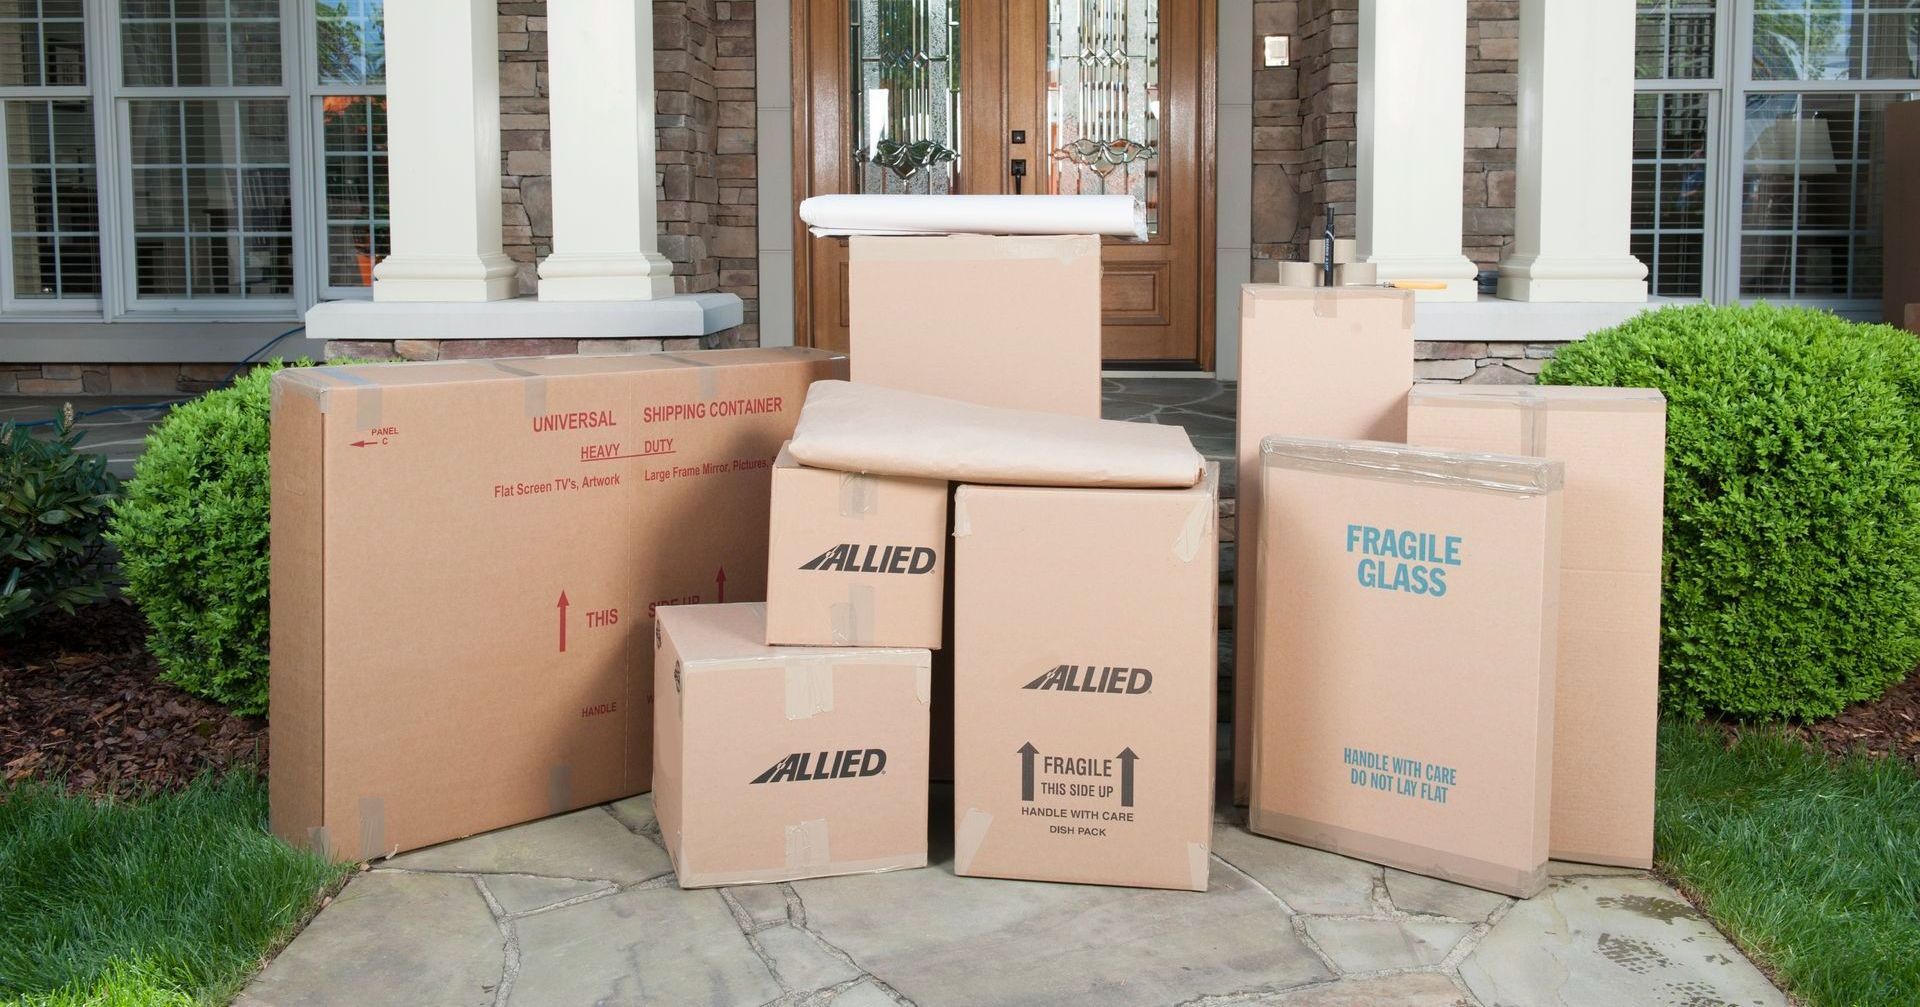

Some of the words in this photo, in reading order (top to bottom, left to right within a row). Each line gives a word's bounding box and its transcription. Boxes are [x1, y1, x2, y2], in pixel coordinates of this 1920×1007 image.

[533, 411, 617, 432] UNIVERSAL
[643, 403, 706, 423] SHIPPING
[709, 397, 783, 418] CONTAINER
[371, 427, 399, 436] PANEL
[382, 437, 388, 445] C
[580, 443, 620, 459] HEAVY
[644, 438, 674, 454] DUTY
[494, 484, 514, 498] Flat
[517, 481, 552, 496] Screen
[555, 478, 579, 491] TV's,
[581, 473, 620, 488] Artwork
[644, 468, 671, 482] Large
[673, 465, 700, 478] Frame
[702, 462, 731, 475] Mirror,
[733, 458, 769, 472] Pictures,
[1346, 524, 1462, 566] FRAGILE
[798, 544, 937, 574] ALLIED
[1357, 558, 1447, 597] GLASS
[586, 608, 618, 628] THIS
[1021, 665, 1153, 694] ALLIED
[582, 702, 617, 718] HANDLE
[749, 748, 887, 784] ALLIED
[1044, 756, 1112, 777] FRAGILE
[1344, 747, 1389, 771] HANDLE
[1392, 757, 1422, 778] WITH
[1426, 763, 1457, 785] CARE
[1041, 782, 1066, 796] THIS
[1069, 783, 1095, 797] SIDE
[1098, 785, 1114, 798] UP
[1351, 768, 1367, 786] DO
[1370, 772, 1394, 791] NOT
[1397, 777, 1417, 797] LAY
[1421, 782, 1448, 803] FLAT
[1021, 807, 1068, 818] HANDLE
[1070, 809, 1099, 820] WITH
[1102, 811, 1134, 822] CARE
[1049, 825, 1075, 835] DISH
[1078, 827, 1107, 836] PACK
